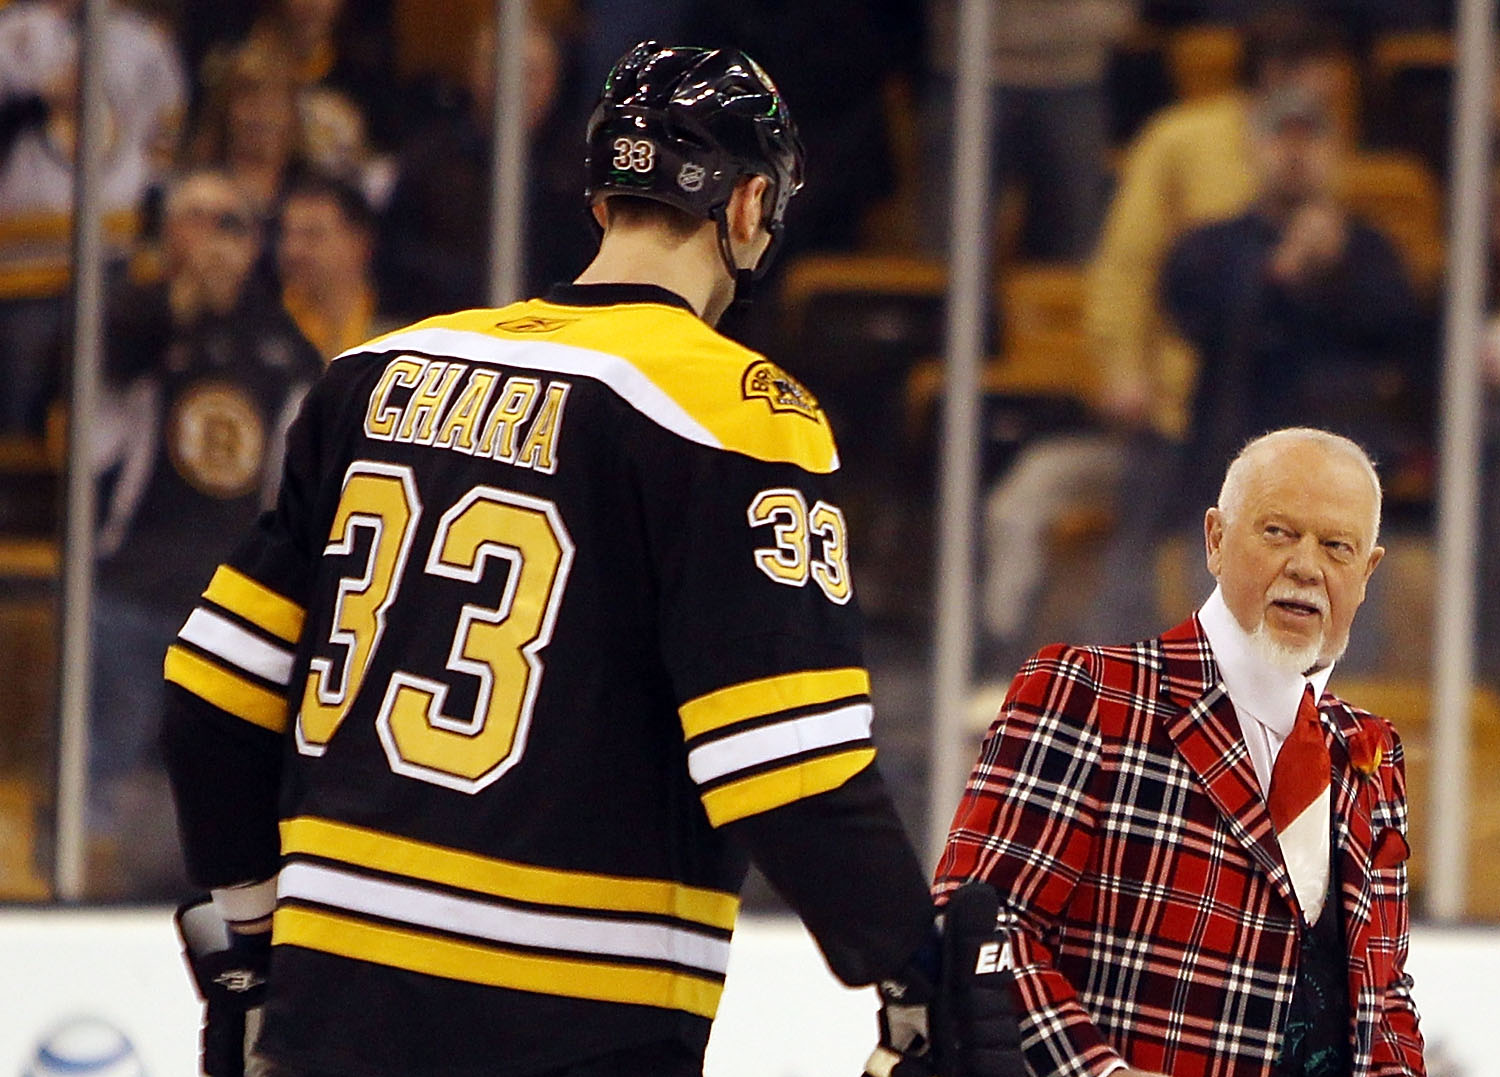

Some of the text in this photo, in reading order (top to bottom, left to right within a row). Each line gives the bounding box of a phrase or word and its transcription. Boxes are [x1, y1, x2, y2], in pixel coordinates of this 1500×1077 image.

[613, 137, 656, 172] 33
[363, 354, 572, 475] CHARA
[747, 488, 853, 605] 33
[296, 459, 576, 795] 33
